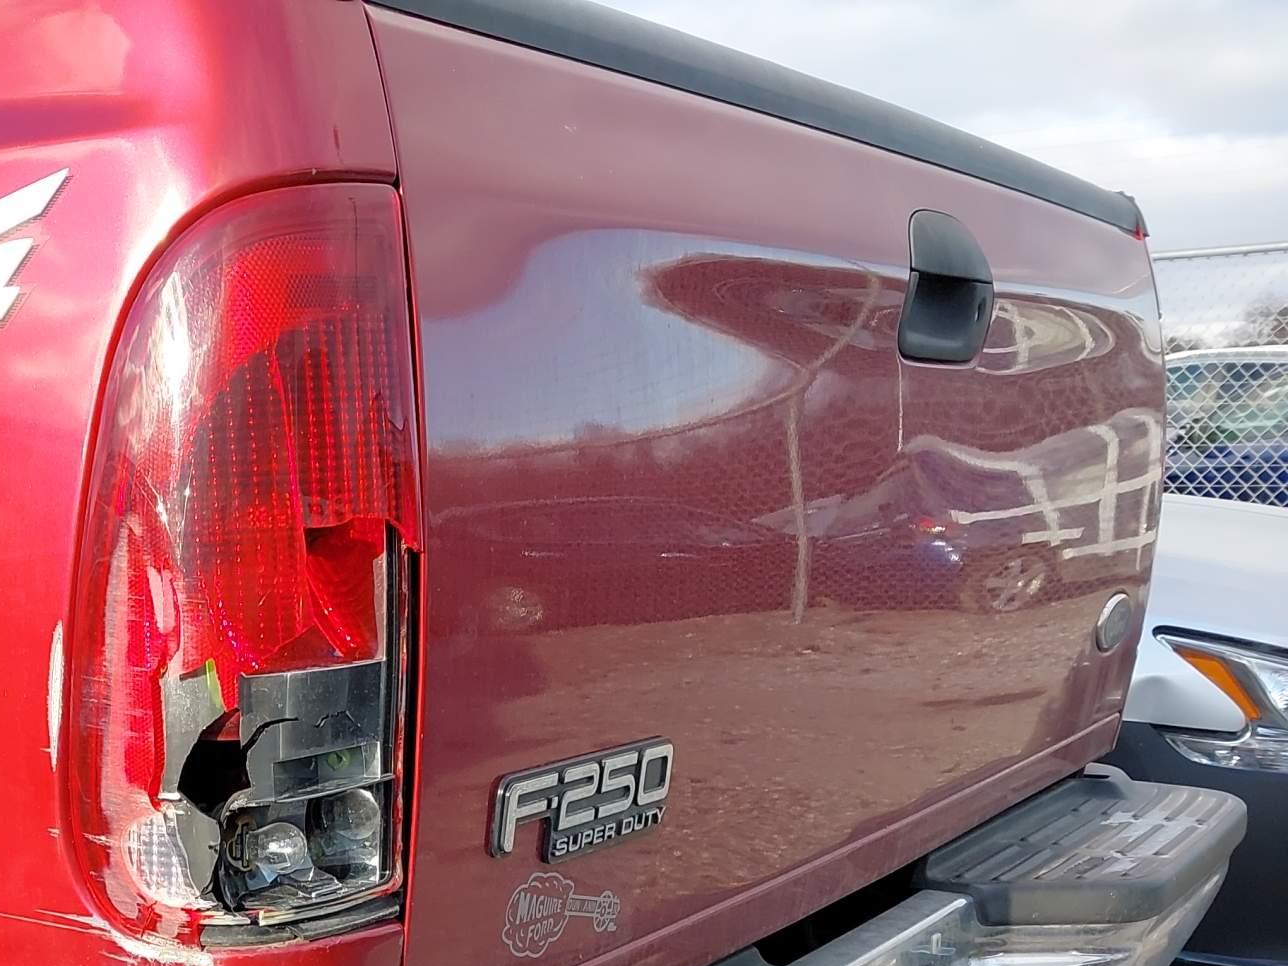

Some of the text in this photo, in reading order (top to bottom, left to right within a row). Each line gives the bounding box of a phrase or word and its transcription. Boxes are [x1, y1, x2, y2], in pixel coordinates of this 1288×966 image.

[553, 806, 667, 857] SUPER DUTY
[515, 890, 564, 925] MAGUIRE
[525, 917, 555, 946] FORD
